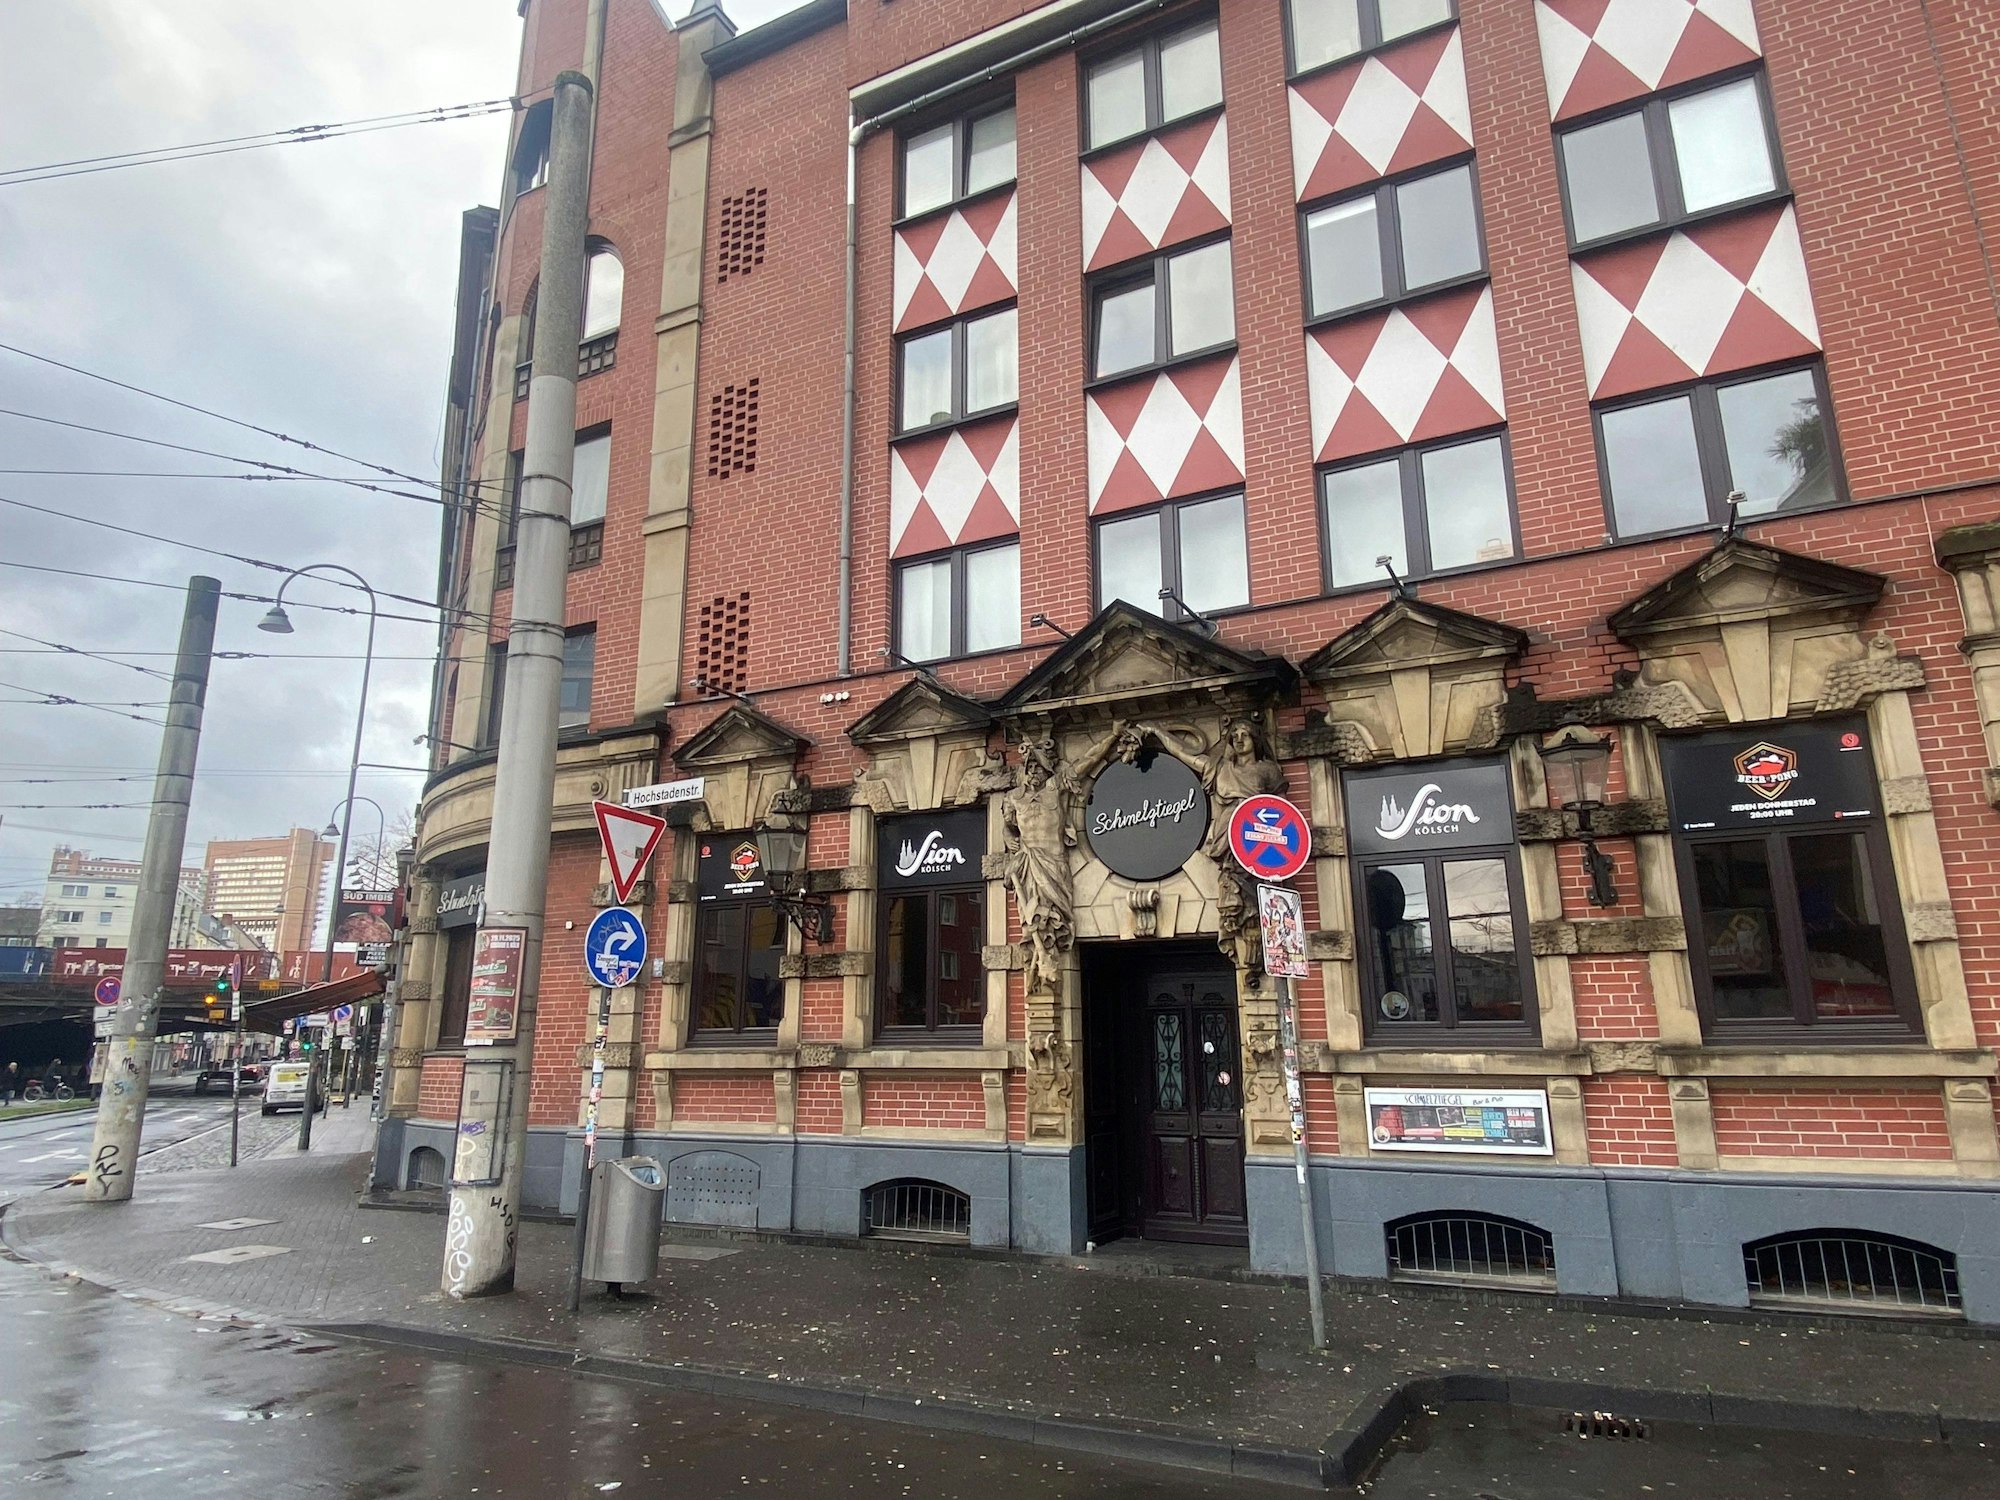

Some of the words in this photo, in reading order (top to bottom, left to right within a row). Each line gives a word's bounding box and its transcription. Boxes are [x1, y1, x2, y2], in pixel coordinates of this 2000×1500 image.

[1737, 774, 1766, 784] BEER
[1770, 769, 1799, 782] PONG
[633, 784, 700, 804] Hochstadenstr.
[1092, 787, 1195, 835] Schmelztiegel
[1374, 783, 1481, 840] Sion
[1730, 802, 1757, 812] JEDEN
[1757, 798, 1817, 810] DONNERSTAG
[1774, 808, 1794, 817] UHR
[1414, 825, 1459, 836] KÖLSCH
[894, 830, 967, 877] Sion
[920, 864, 952, 874] KÖLSCH
